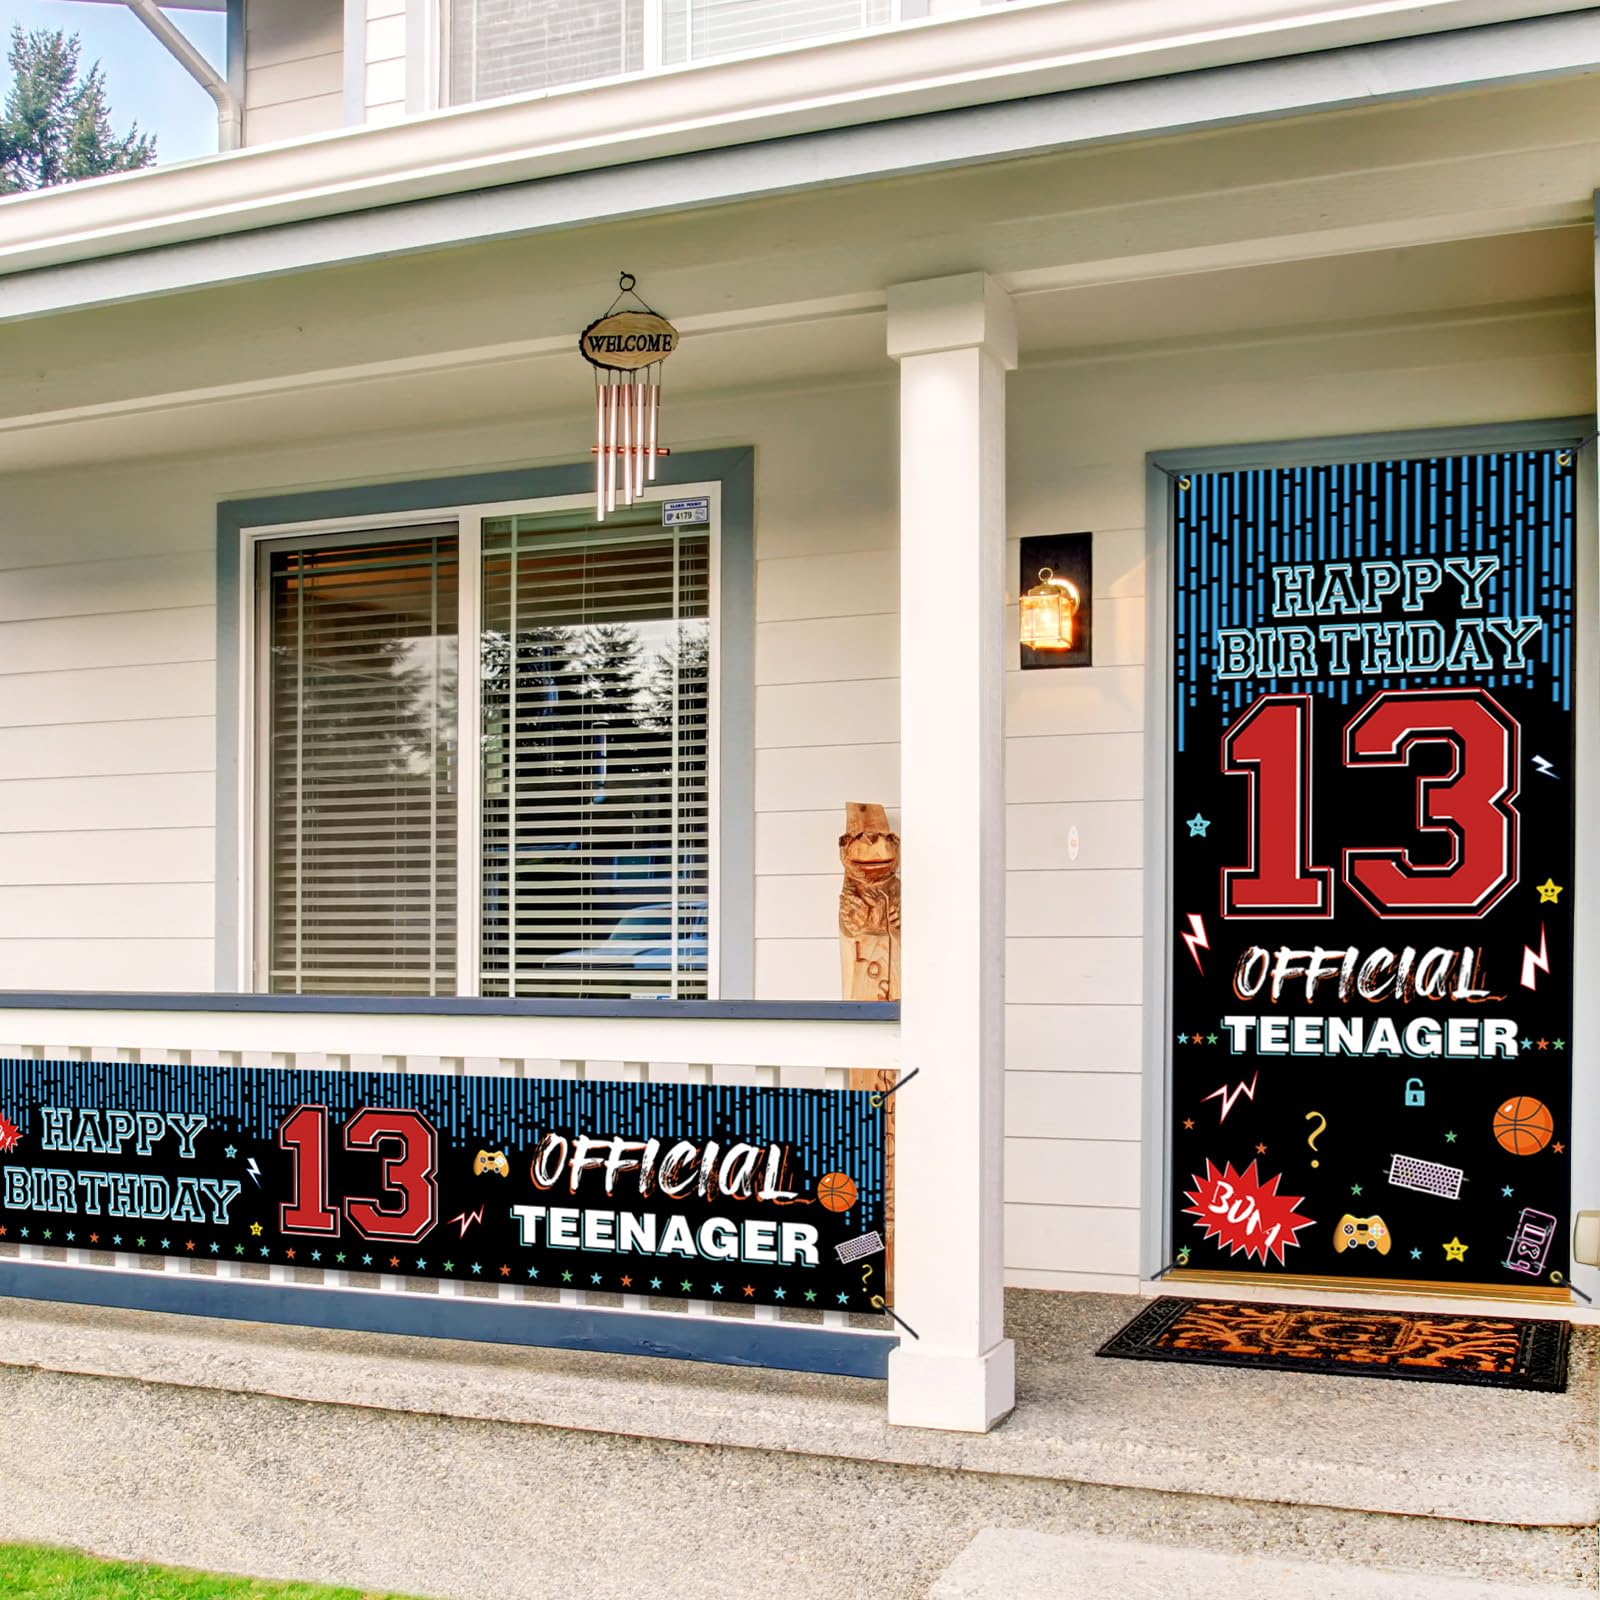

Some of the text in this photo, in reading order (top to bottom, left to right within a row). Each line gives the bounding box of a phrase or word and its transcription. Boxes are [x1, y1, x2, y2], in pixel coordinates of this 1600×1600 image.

[588, 333, 672, 352] WELCOME
[675, 511, 693, 521] 4179
[1272, 555, 1500, 617] HAPPY
[1217, 616, 1542, 680] BIRTHDAY
[1221, 688, 1521, 920] 13
[1233, 945, 1506, 1004] OFFICIAL
[1221, 1015, 1519, 1060] TEENAGER
[41, 1106, 208, 1158] HAPPY
[3, 1165, 241, 1226] BIRTHDAY
[278, 1104, 438, 1244] 13
[531, 1132, 816, 1206] OFFICIAL
[510, 1204, 820, 1268] TEENAGER
